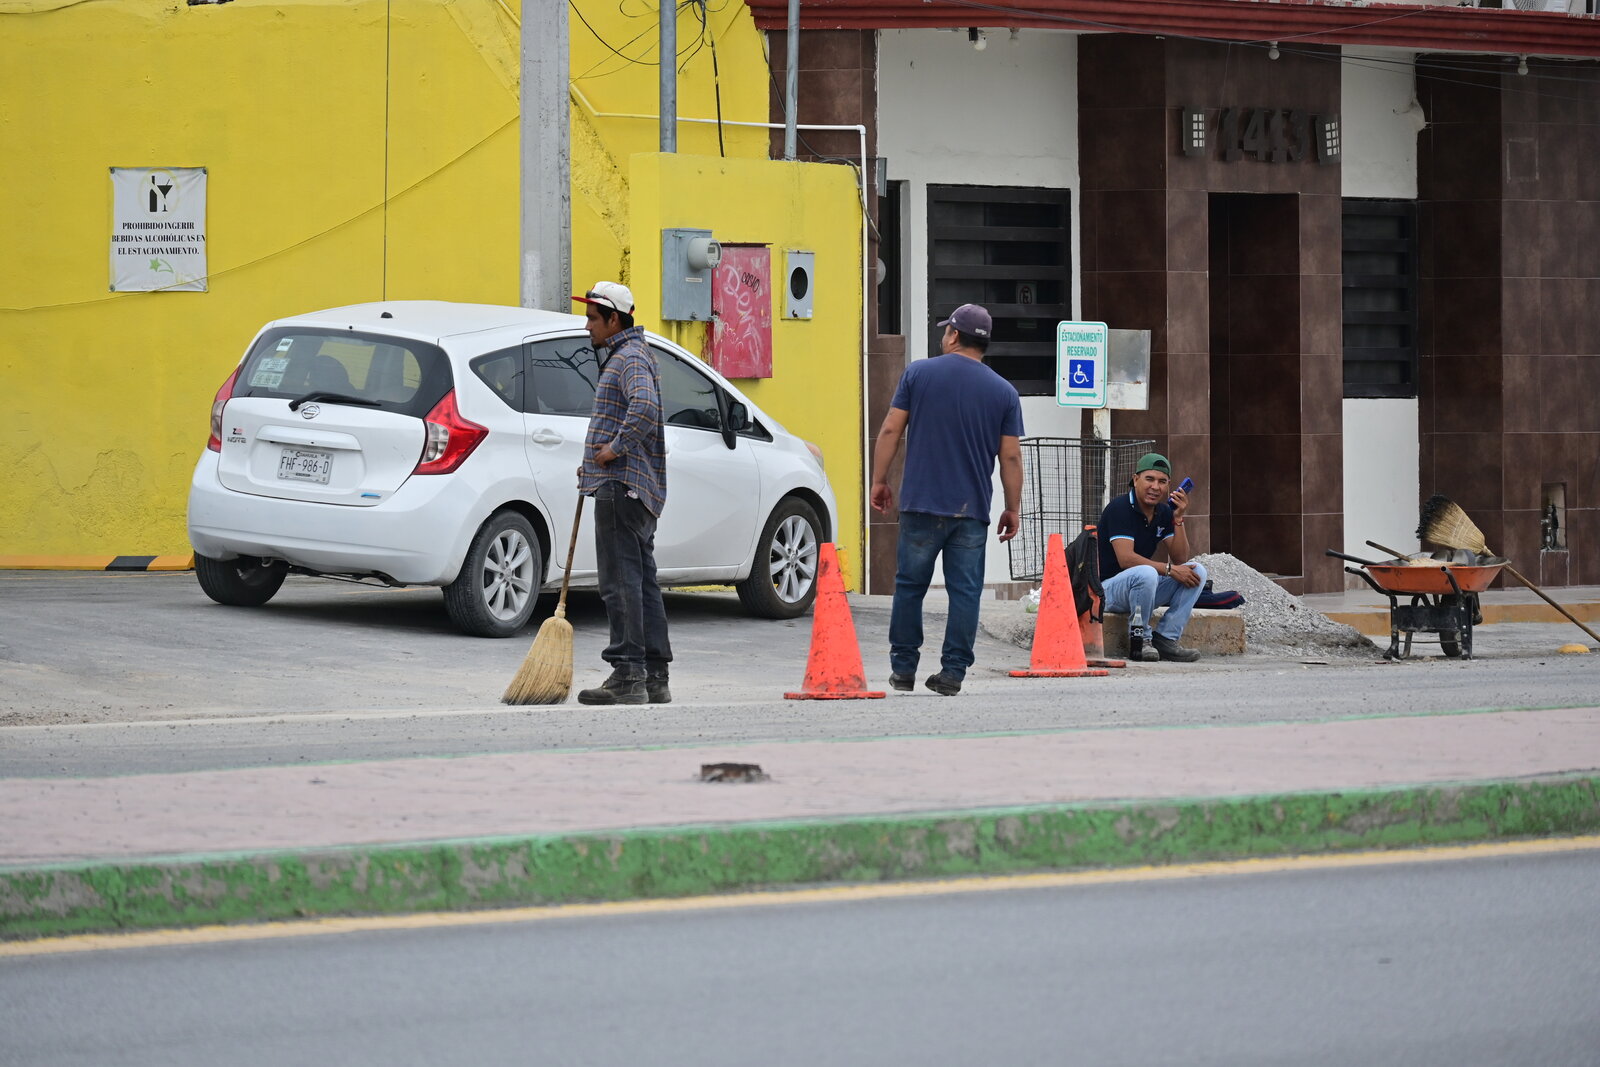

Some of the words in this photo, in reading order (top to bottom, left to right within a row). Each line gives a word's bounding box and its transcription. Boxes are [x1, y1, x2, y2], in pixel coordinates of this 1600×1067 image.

[122, 222, 164, 230] PROHIBIDO
[164, 222, 195, 230] INGERIR
[111, 235, 143, 243] BEBIDAS
[144, 233, 196, 243] ALCOHÓLICAS
[117, 247, 127, 255] EL
[128, 247, 200, 255] ESTACIONAMIENTO.
[1061, 331, 1103, 343] ESTACIONAMIENTO
[1066, 346, 1098, 356] RESERVADO
